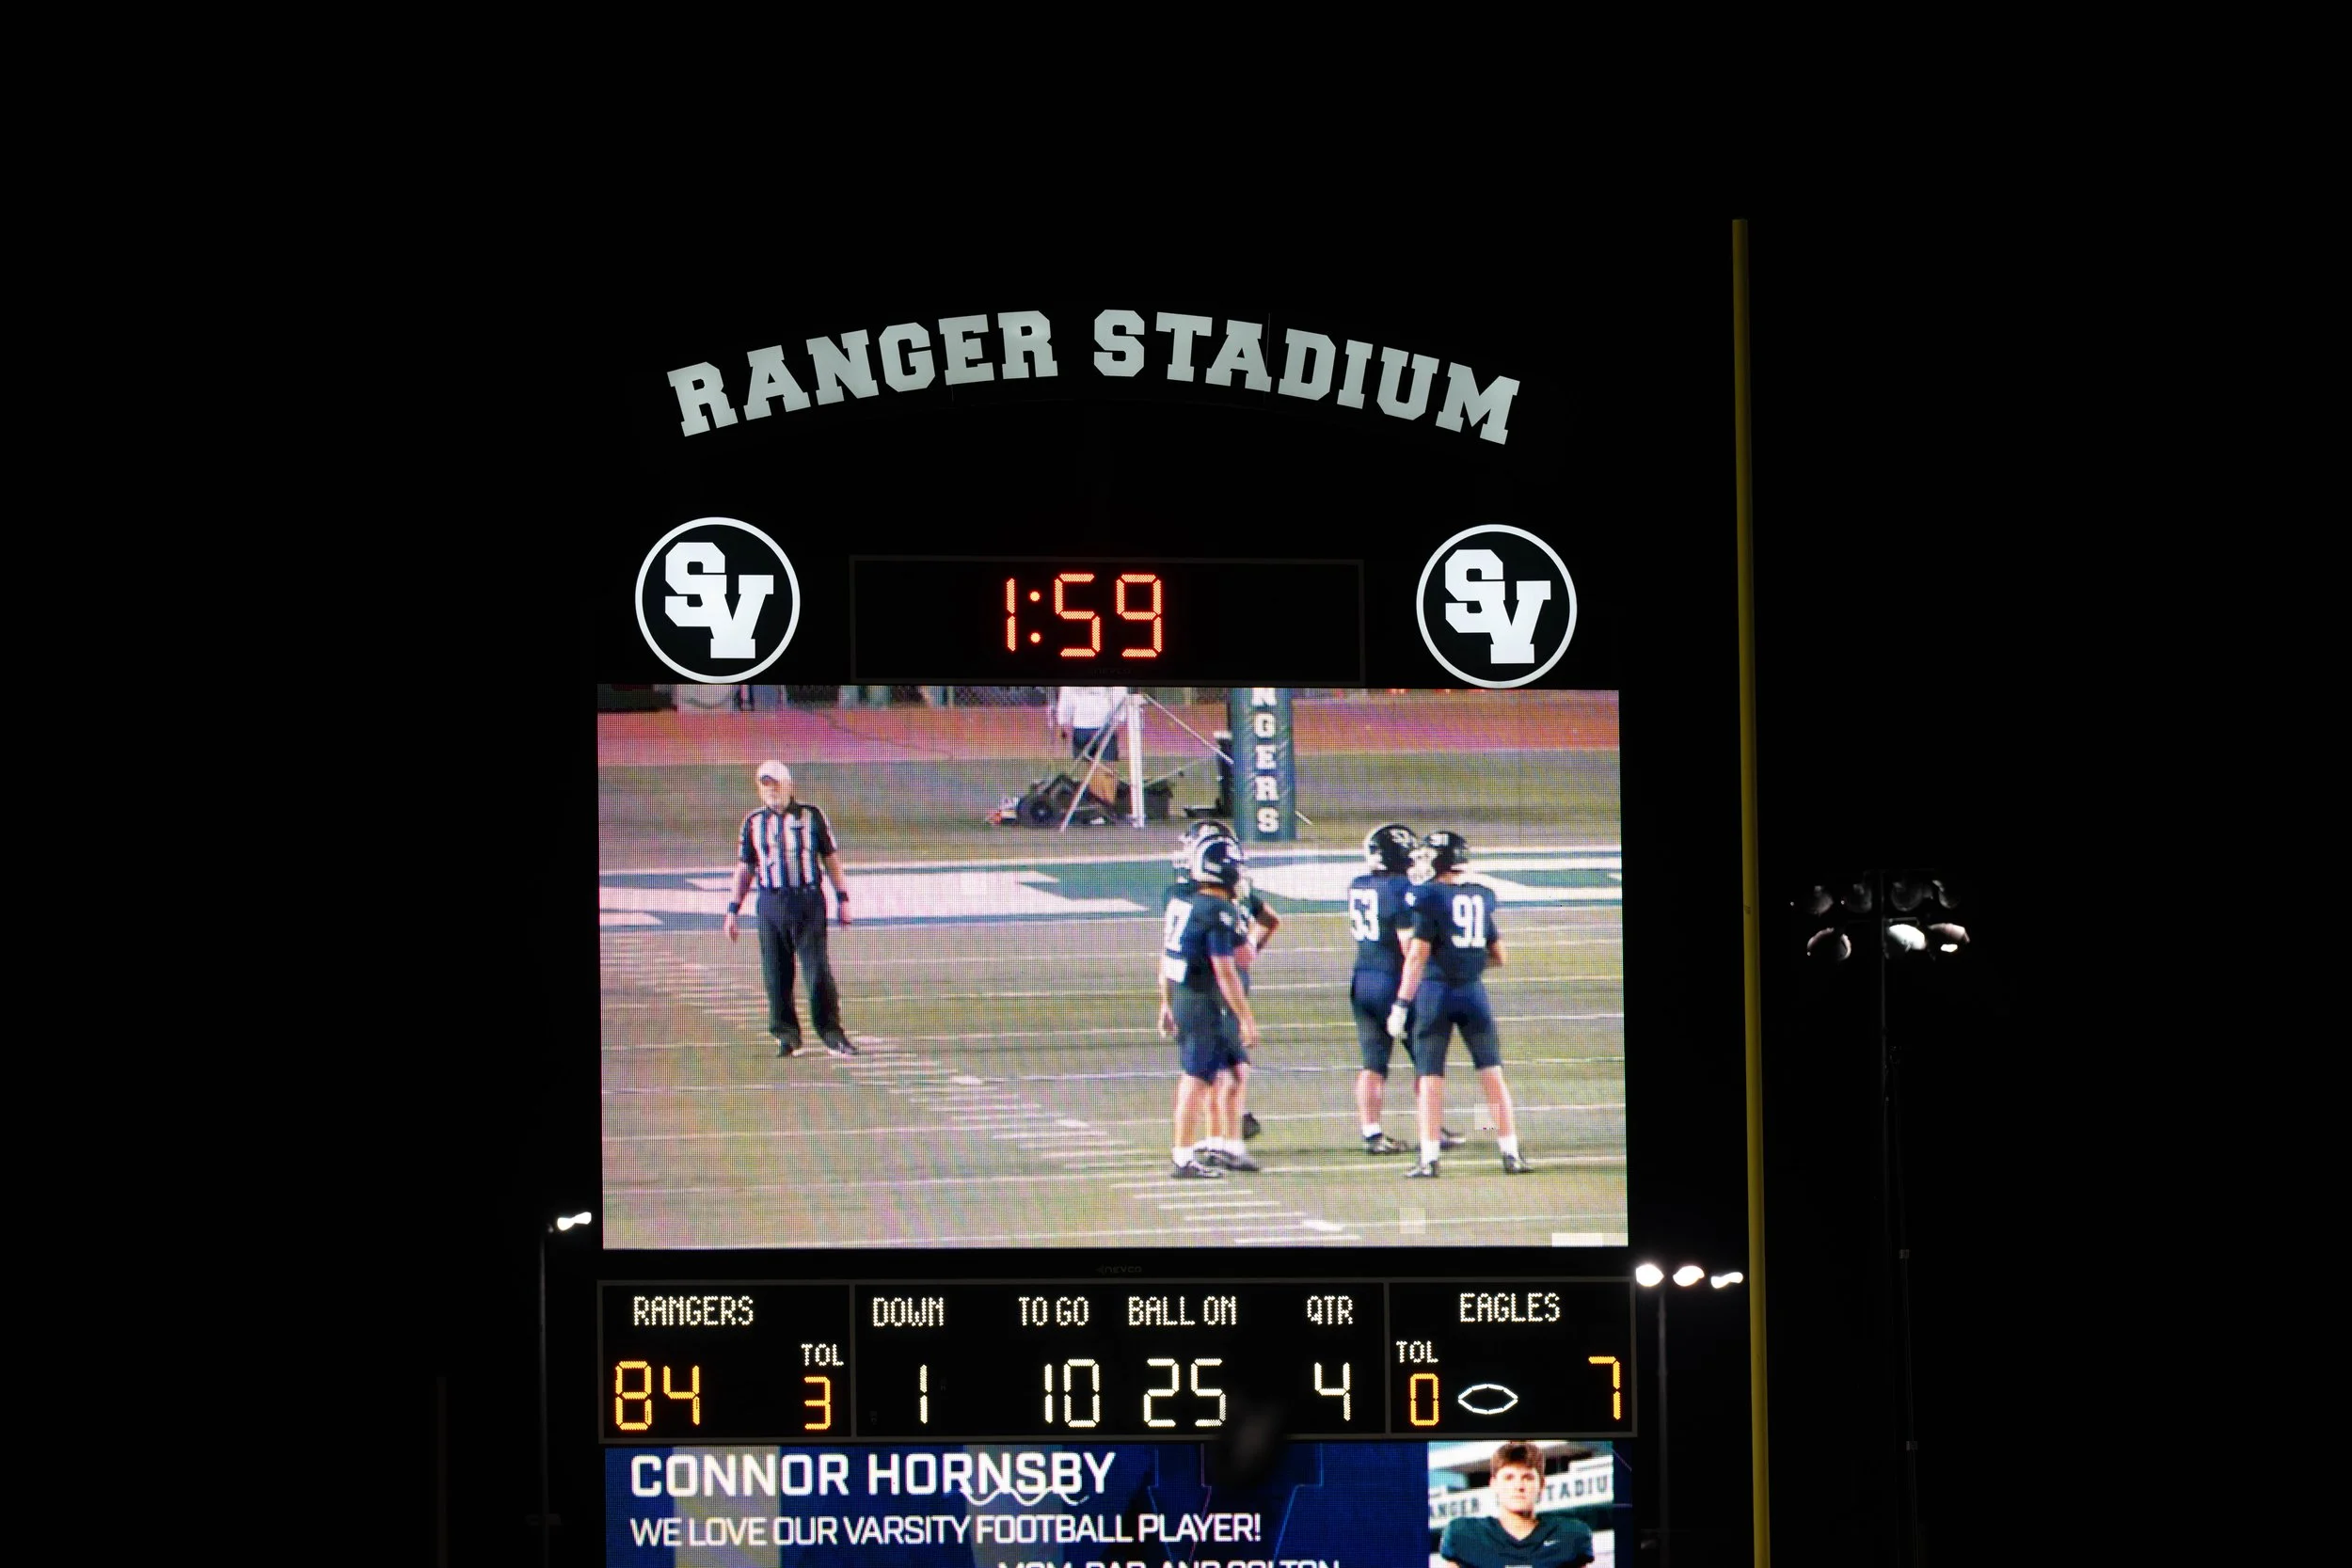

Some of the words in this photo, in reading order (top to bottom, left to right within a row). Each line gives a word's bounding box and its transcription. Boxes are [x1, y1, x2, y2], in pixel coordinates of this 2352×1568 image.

[667, 310, 1057, 436] RANGER
[1094, 309, 1519, 444] STADIUM
[665, 542, 774, 659] SV
[1005, 573, 1163, 658] 1:59
[1445, 548, 1552, 665] SV
[1350, 889, 1380, 942] 53
[1451, 895, 1486, 949] 91
[634, 1296, 753, 1325] RANGERS
[873, 1297, 944, 1326] DOWN
[1019, 1297, 1048, 1326] TO
[1057, 1296, 1089, 1326] GO
[1129, 1296, 1195, 1325] BALL
[1204, 1296, 1236, 1325] ON
[1307, 1295, 1353, 1324] QTR
[1460, 1292, 1560, 1323] EAGLES
[801, 1343, 844, 1366] TOL
[1396, 1340, 1438, 1363] TOL
[615, 1361, 700, 1431] 84
[804, 1376, 831, 1430] 3
[920, 1365, 928, 1423] 1
[1044, 1359, 1100, 1428] 10
[1144, 1358, 1226, 1427] 25
[1314, 1362, 1350, 1421] 4
[1409, 1373, 1439, 1426] 0
[1588, 1356, 1621, 1419] 7
[632, 1454, 848, 1497] CONNOR
[869, 1453, 1114, 1496] HORNSBY
[1536, 1475, 1608, 1503] TADIU
[631, 1518, 681, 1545] WE
[690, 1517, 767, 1546] LOVE
[773, 1517, 836, 1544] OUR
[844, 1516, 970, 1544] VARSITY
[977, 1515, 1132, 1543] FOOTBALL
[1140, 1514, 1260, 1542] PLAYER!
